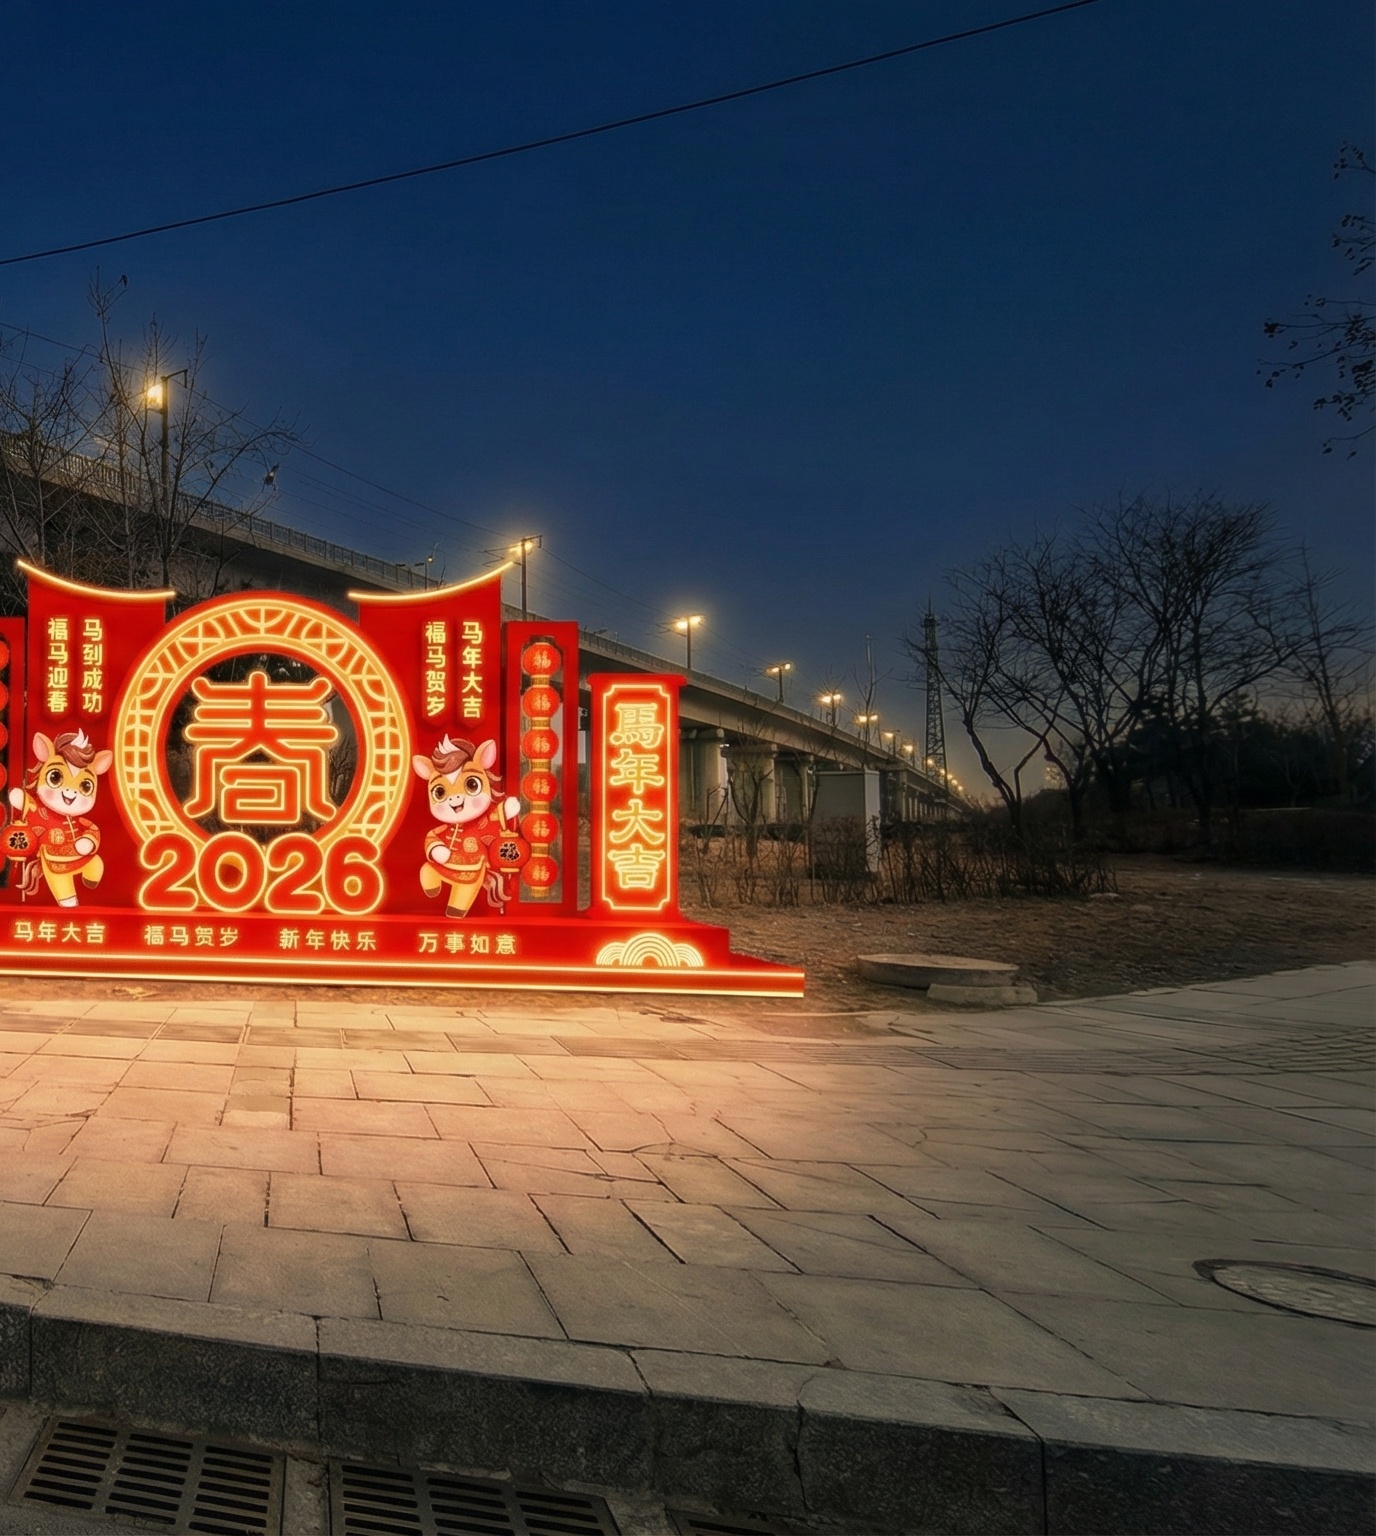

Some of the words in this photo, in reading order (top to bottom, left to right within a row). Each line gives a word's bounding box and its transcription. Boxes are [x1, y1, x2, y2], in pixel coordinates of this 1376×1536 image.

[47, 617, 69, 713] 福马迎春
[81, 617, 104, 714] 马到成功
[425, 620, 446, 716] 福马贺岁
[461, 620, 483, 719] 马年大吉
[183, 670, 339, 825] 春
[138, 831, 384, 914] 2026
[13, 919, 107, 945] 马年大吉
[143, 923, 241, 948] 福马贺岁
[278, 927, 378, 952] 新年快乐
[417, 931, 519, 956] 万事如意
